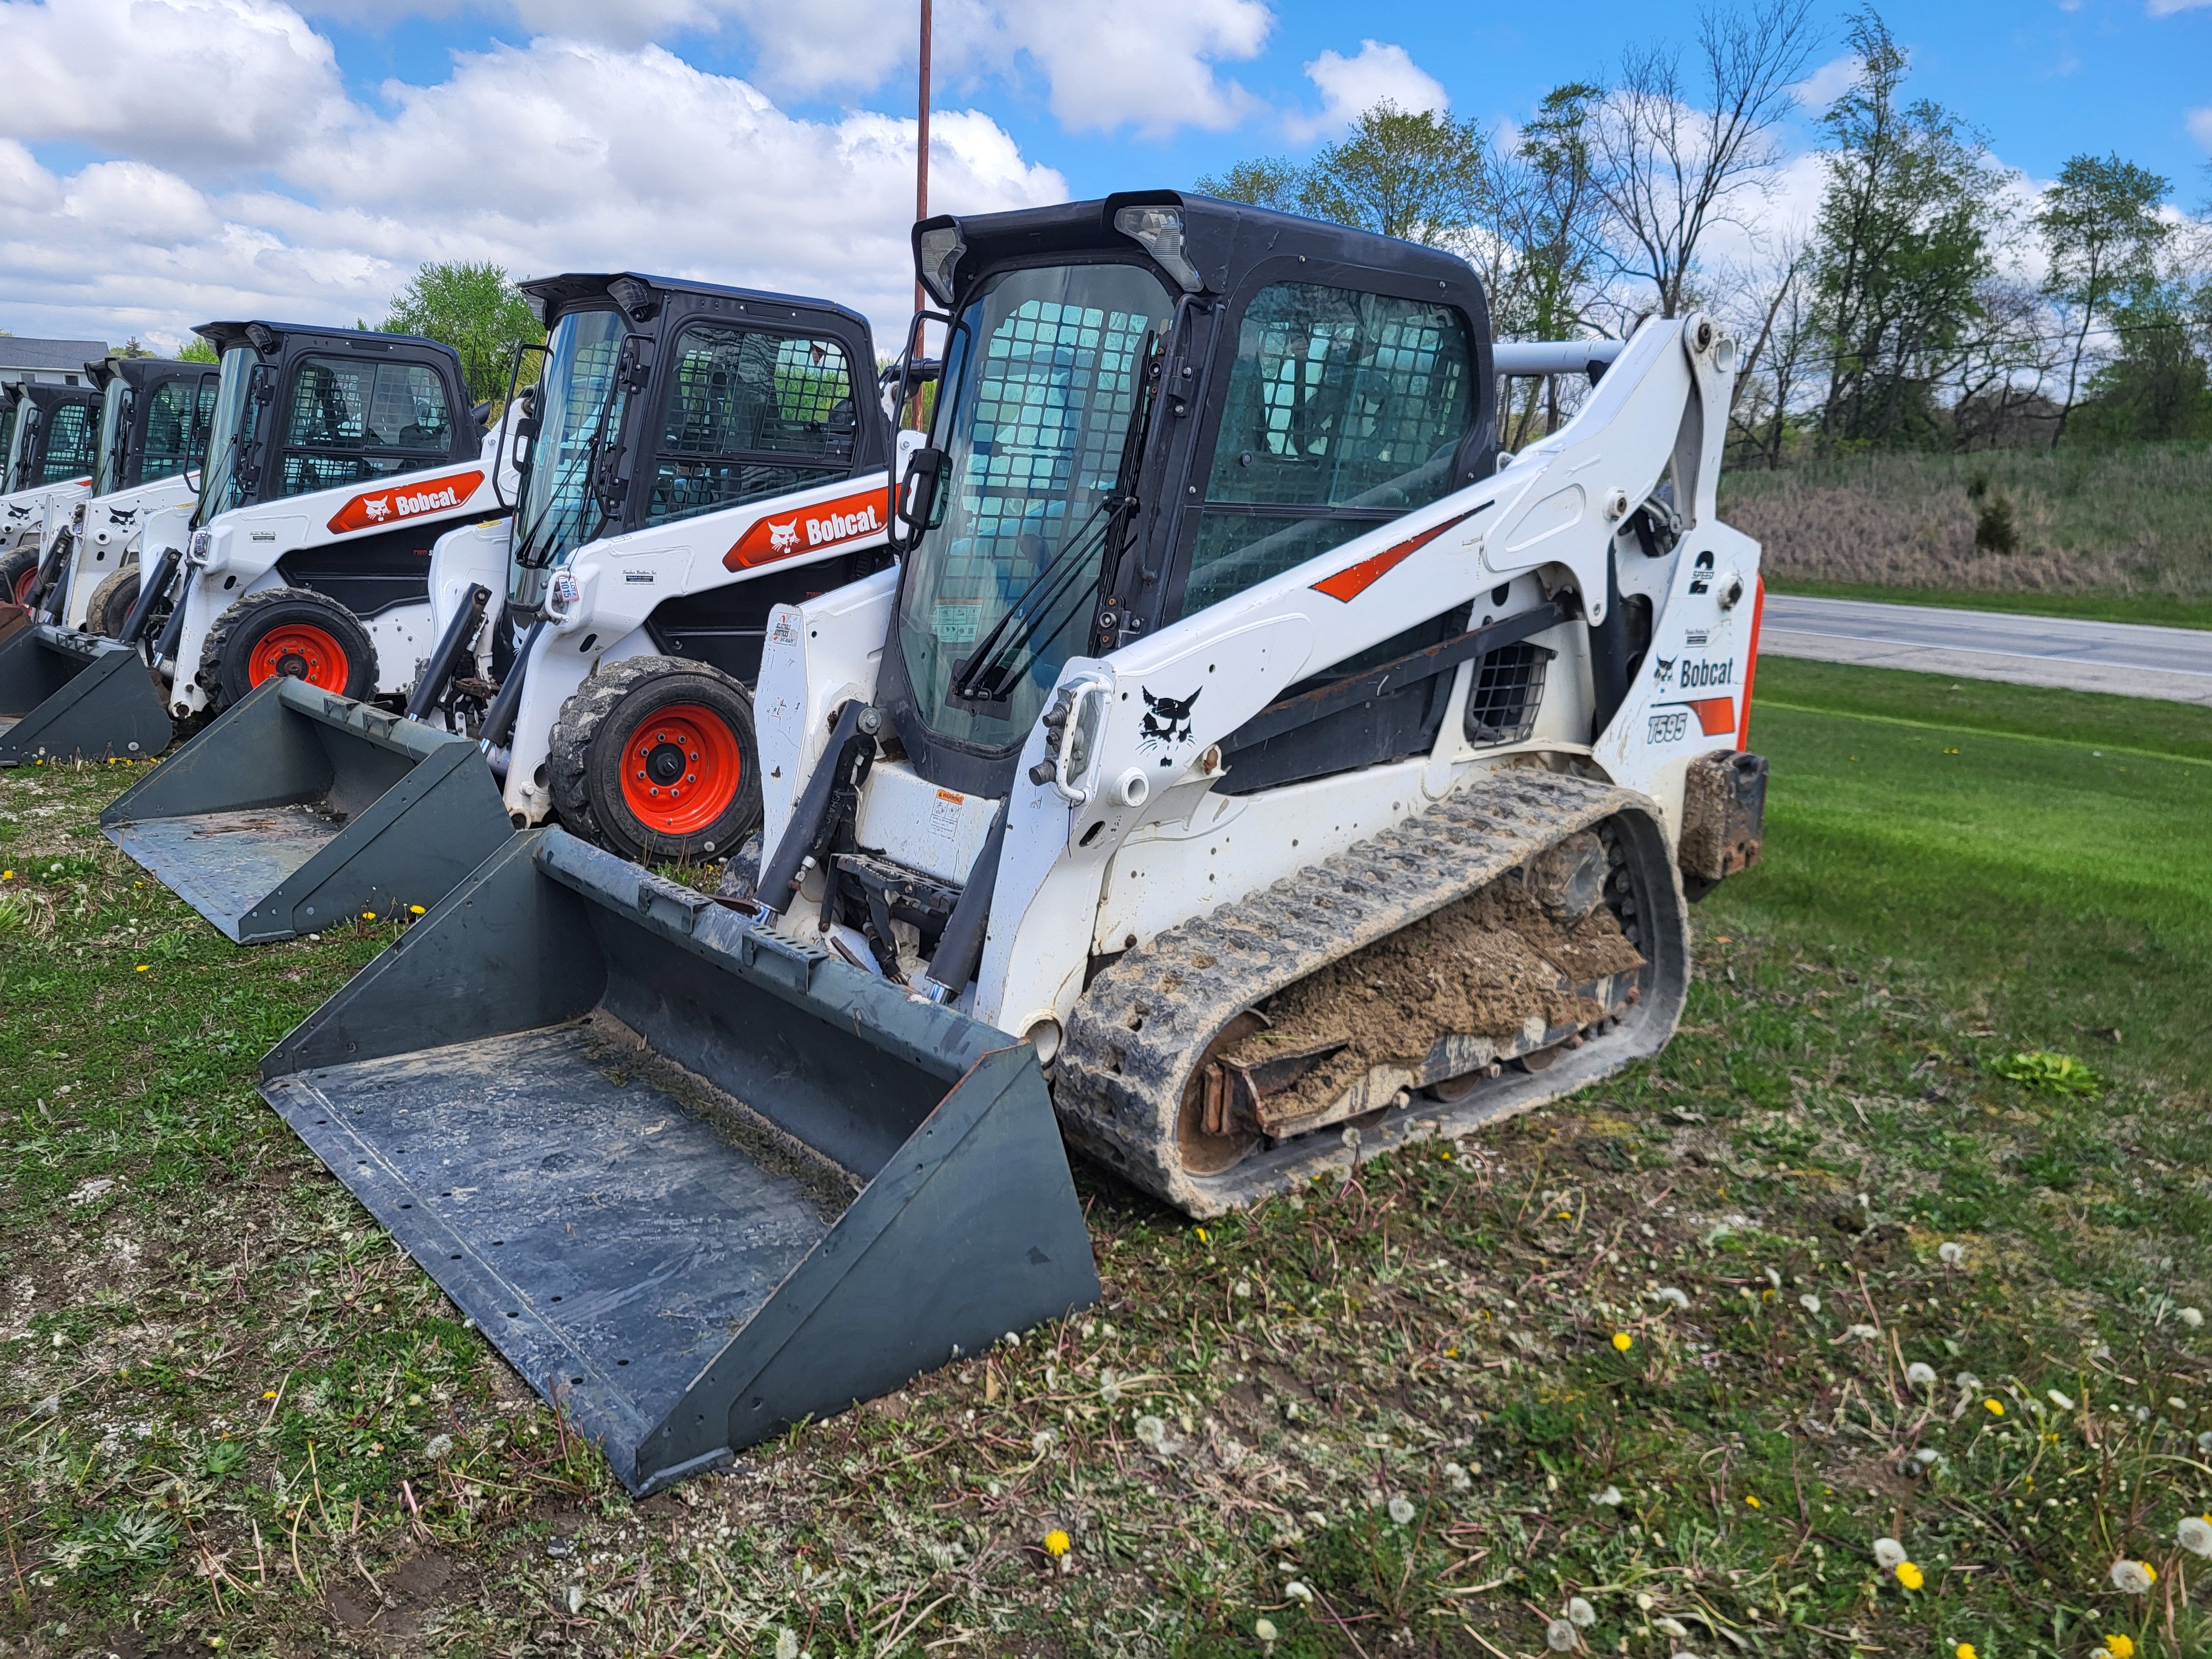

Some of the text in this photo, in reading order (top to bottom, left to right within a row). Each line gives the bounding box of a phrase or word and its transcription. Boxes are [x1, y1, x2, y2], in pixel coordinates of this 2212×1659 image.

[395, 487, 457, 516] Bobcat
[806, 505, 877, 545] Bobcat
[560, 580, 572, 598] 1015
[1692, 570, 1714, 580] SPEED
[1680, 658, 1733, 688] Bobcat
[1647, 713, 1688, 744] T595
[943, 792, 962, 803] WARNING
